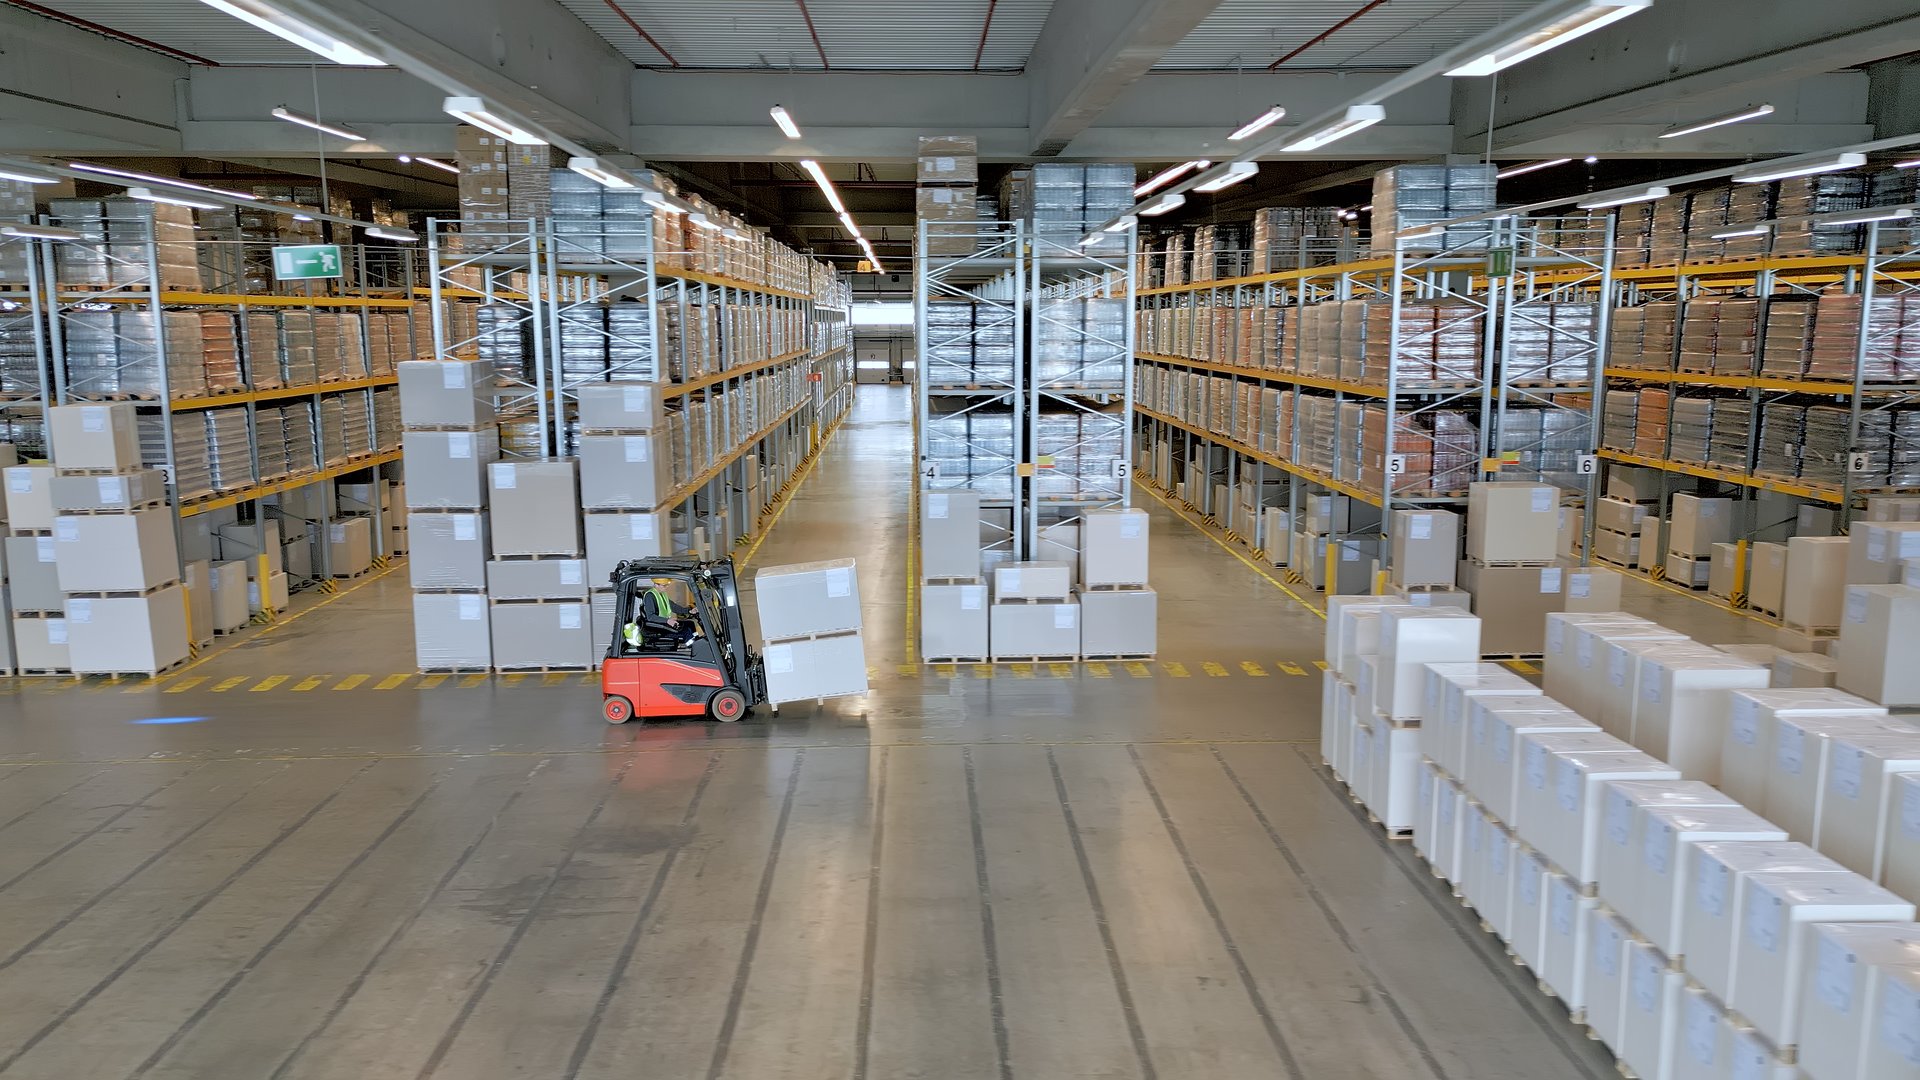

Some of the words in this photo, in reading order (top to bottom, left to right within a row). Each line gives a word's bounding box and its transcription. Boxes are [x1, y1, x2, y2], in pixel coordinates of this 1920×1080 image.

[1391, 459, 1400, 472] 5
[1583, 459, 1592, 472] 6
[1855, 457, 1863, 470] 6
[926, 466, 935, 479] 4
[1118, 464, 1126, 477] 5
